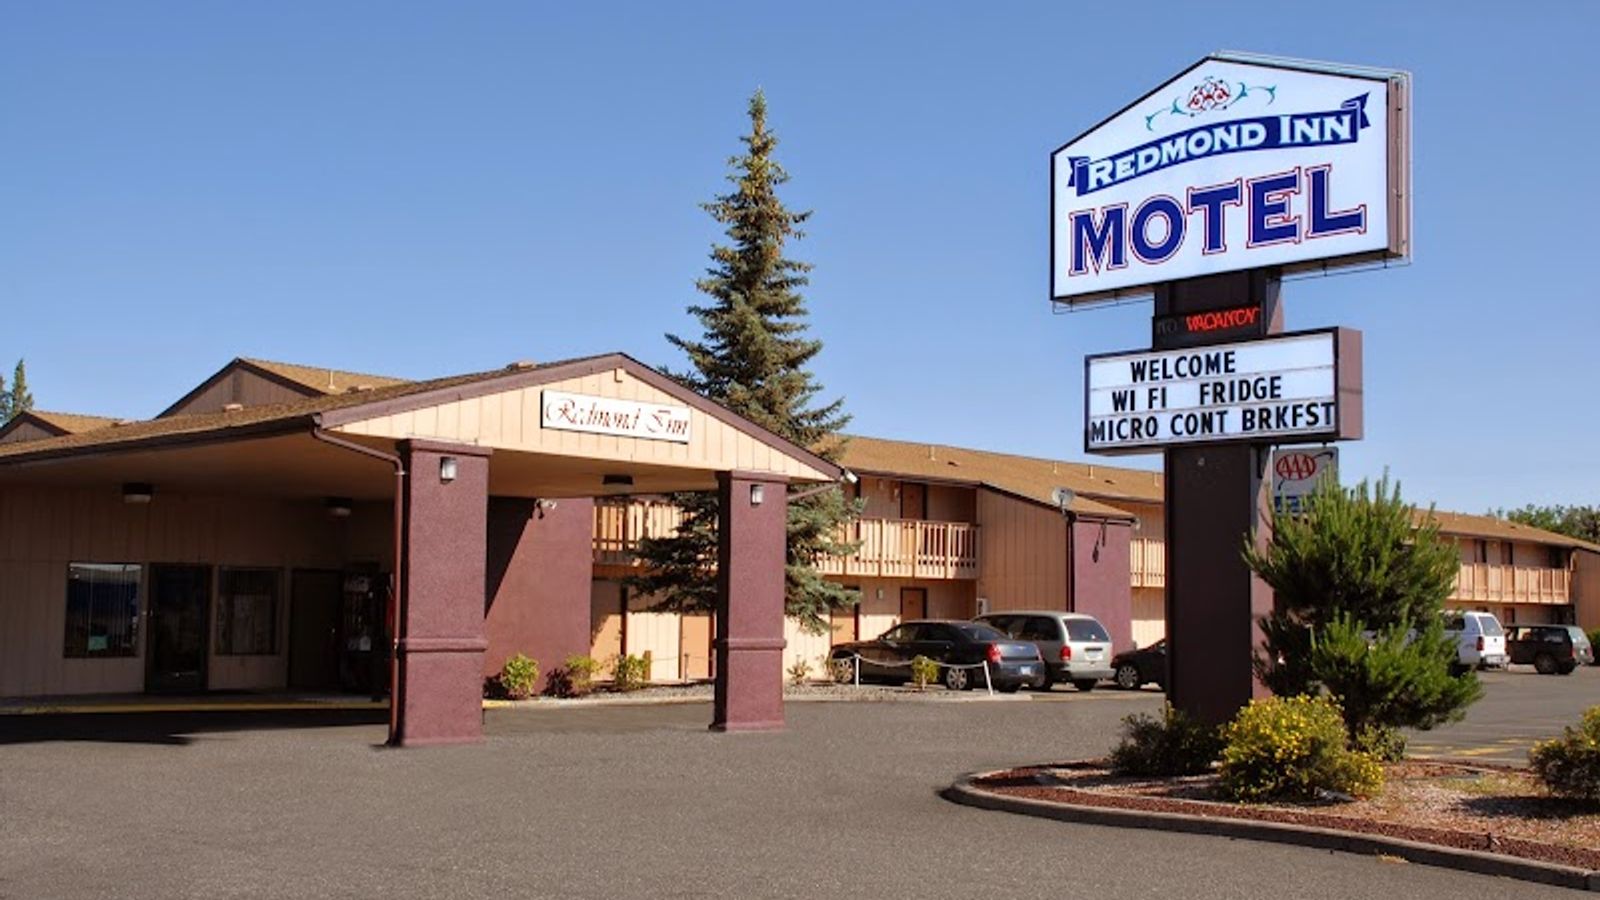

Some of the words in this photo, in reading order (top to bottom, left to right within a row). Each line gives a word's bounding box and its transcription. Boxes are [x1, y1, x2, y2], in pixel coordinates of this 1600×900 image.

[1088, 124, 1267, 191] REDMOND
[1279, 114, 1354, 144] INN
[1068, 163, 1368, 277] MOTEL
[1186, 306, 1261, 331] VACANCY
[1130, 351, 1235, 383] WELCOME
[1112, 390, 1135, 412] WI
[1148, 387, 1166, 409] FI
[1200, 376, 1281, 405] FRIDGE
[1091, 416, 1158, 442] MICRO
[1170, 410, 1228, 436] CONT
[1242, 402, 1335, 431] BRKFST
[1276, 454, 1316, 480] AAA
